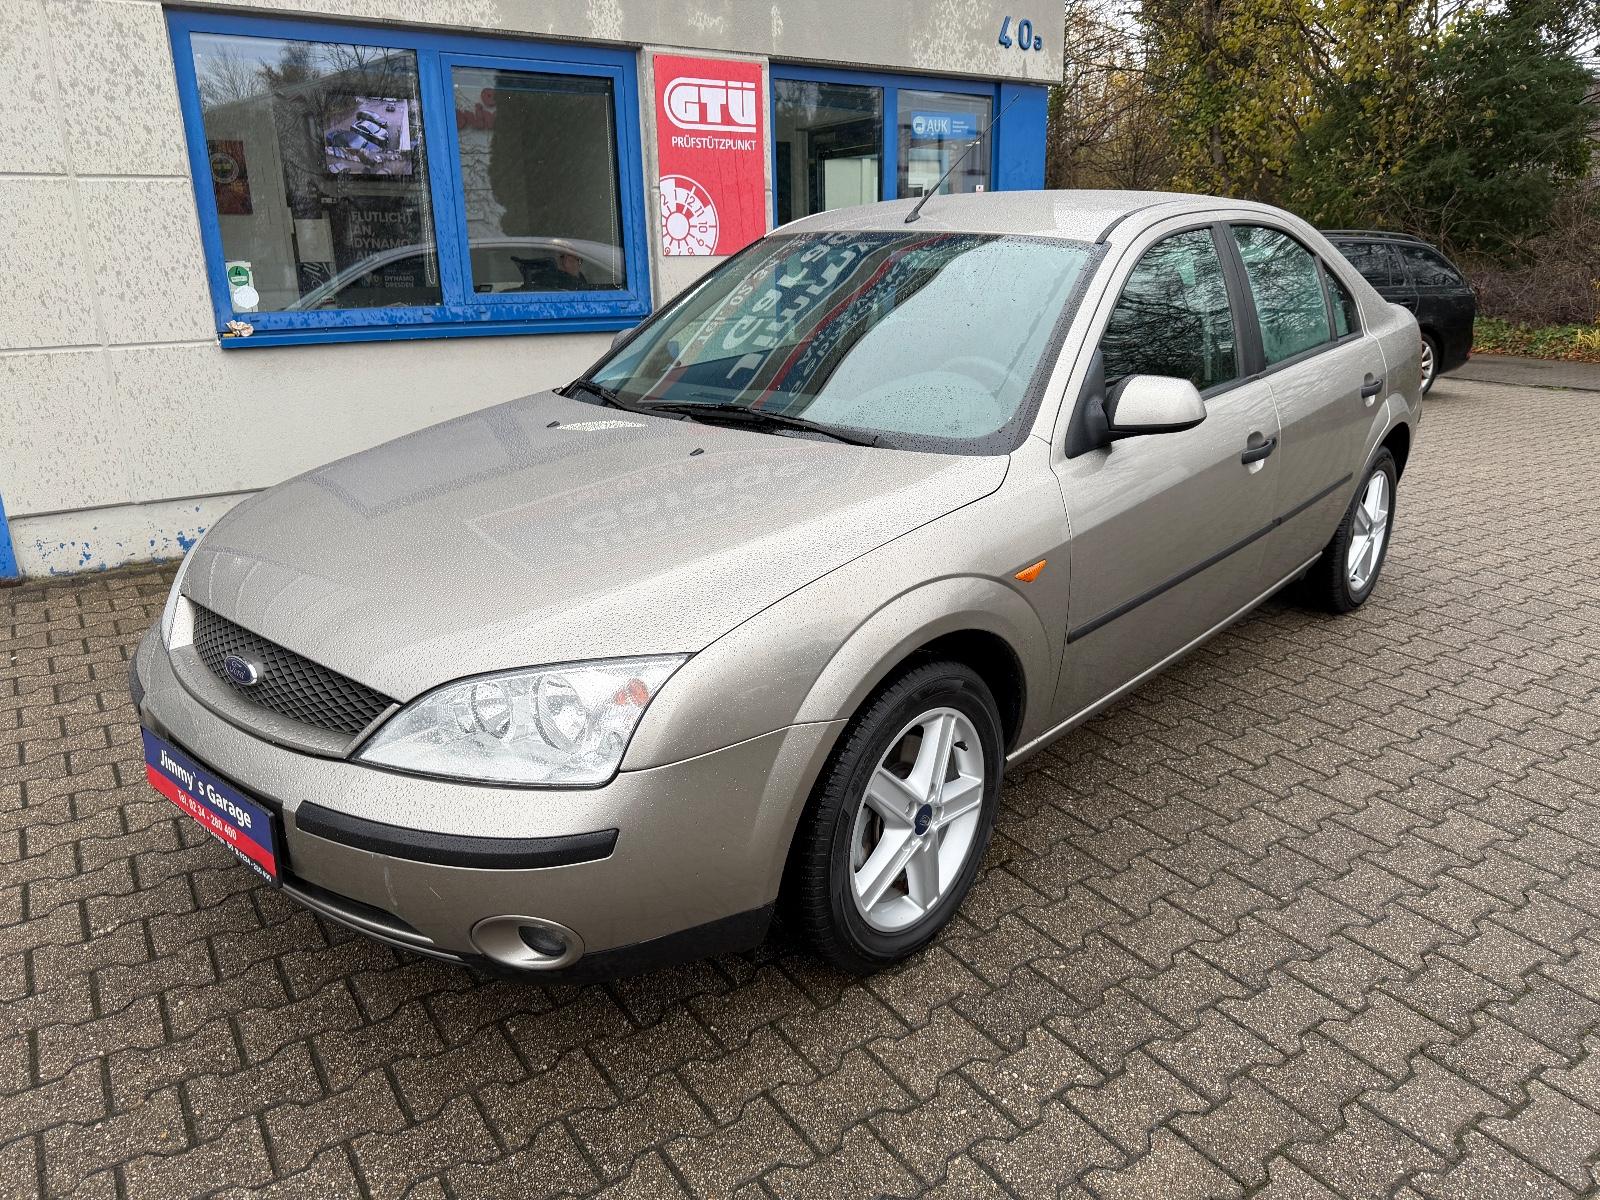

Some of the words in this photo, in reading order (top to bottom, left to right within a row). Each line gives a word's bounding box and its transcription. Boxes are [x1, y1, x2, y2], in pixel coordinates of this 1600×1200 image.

[998, 15, 1043, 51] 40a
[670, 80, 757, 126] GTÜ
[926, 119, 948, 133] AUK
[671, 135, 757, 151] PRÜFSTÜTZPUNKT
[684, 192, 696, 208] 12
[351, 210, 413, 225] FLUTLICHT
[694, 205, 705, 218] 11
[698, 221, 708, 233] 10
[354, 237, 410, 249] DYNAMO
[177, 789, 189, 807] Tel.
[206, 783, 252, 829] Garage
